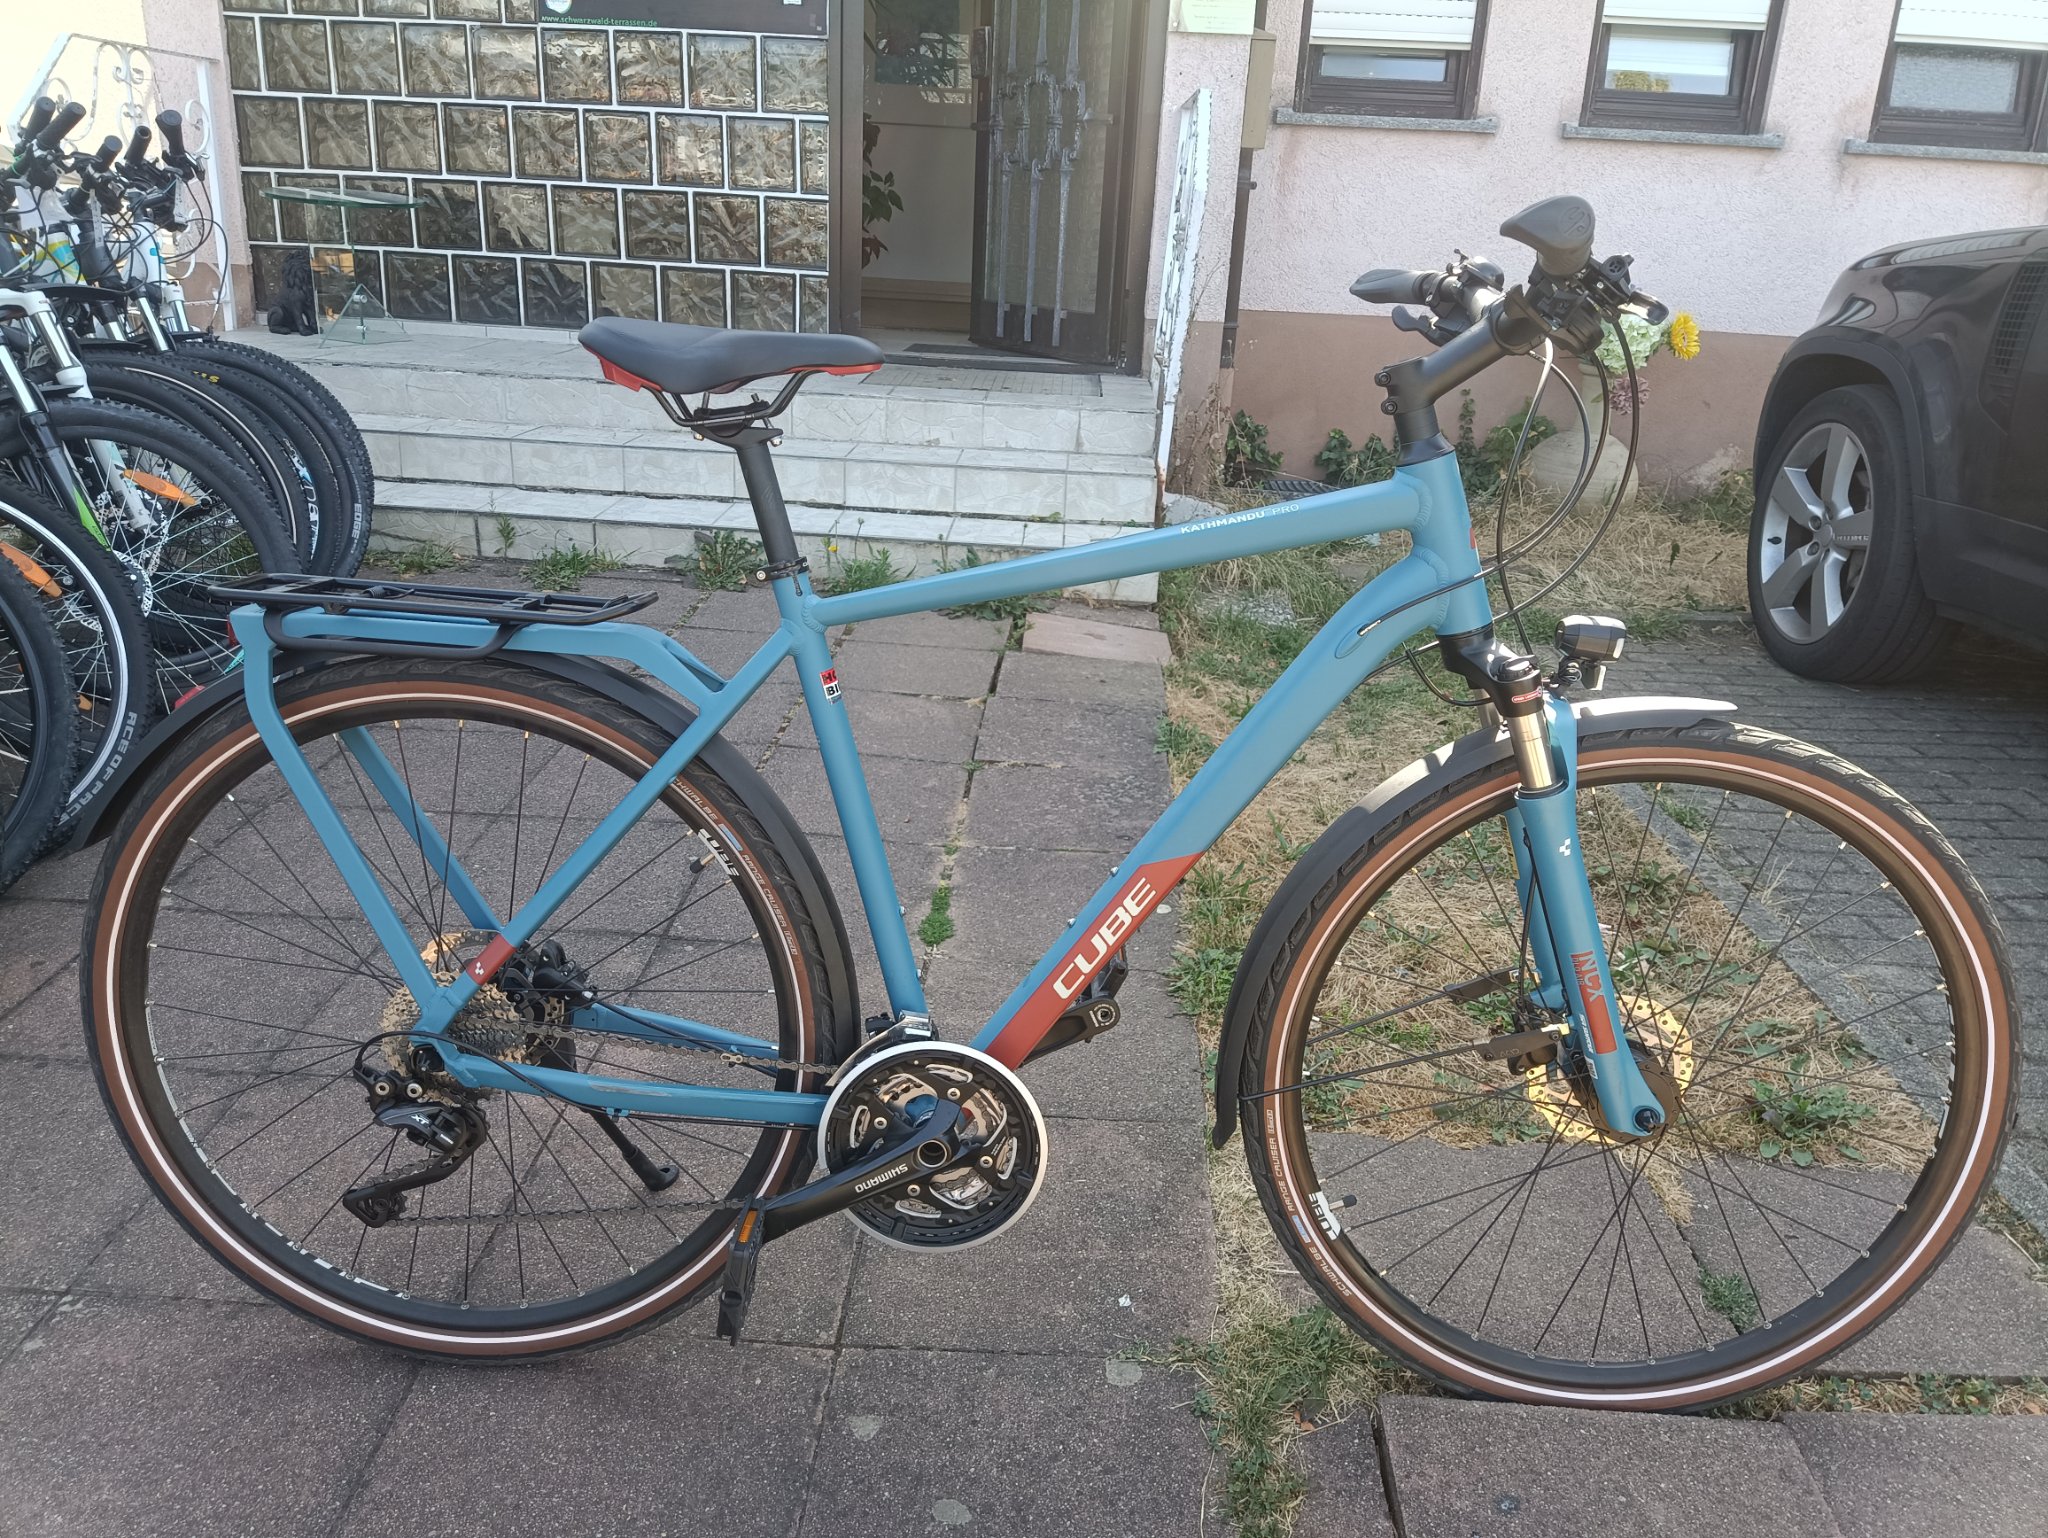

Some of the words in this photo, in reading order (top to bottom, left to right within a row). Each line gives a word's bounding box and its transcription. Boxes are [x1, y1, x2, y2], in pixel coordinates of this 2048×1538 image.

[541, 16, 658, 26] www.schwarzwald-terrassen.de
[351, 503, 363, 540] EDGE
[1181, 511, 1265, 534] KATHMANDU
[1271, 503, 1299, 516] PRO
[117, 711, 138, 755] ACE
[102, 754, 123, 782] OF
[1053, 877, 1156, 999] CUBE
[410, 1114, 429, 1124] XT
[1269, 1137, 1283, 1177] CRUISER
[854, 1162, 909, 1194] SHIMANO
[1278, 1180, 1295, 1212] RANGE
[1309, 1246, 1352, 1297] SCHWALBE
